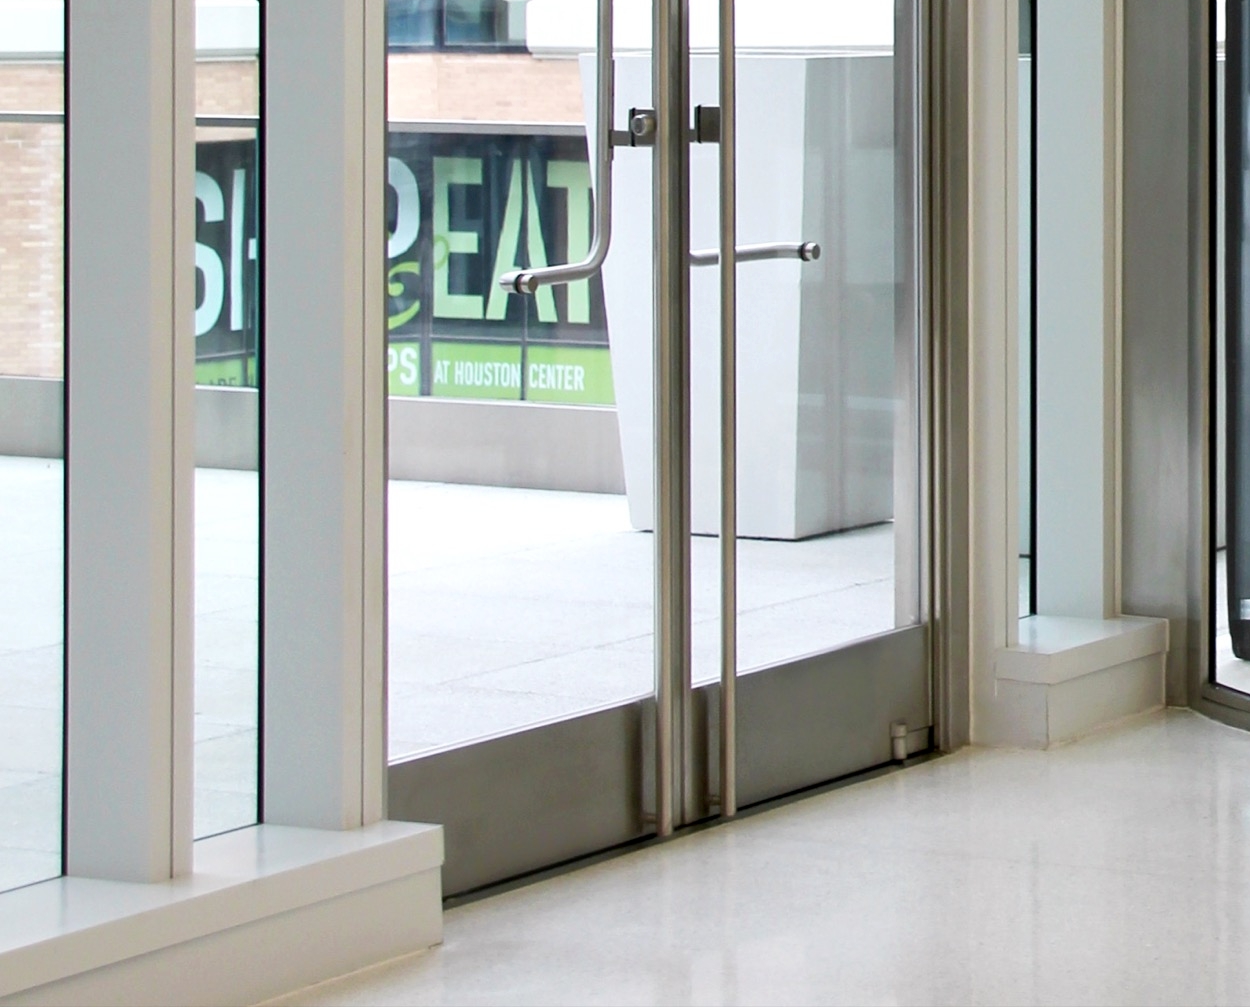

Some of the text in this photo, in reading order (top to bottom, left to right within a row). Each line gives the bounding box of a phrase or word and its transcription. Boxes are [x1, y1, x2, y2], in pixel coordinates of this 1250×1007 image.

[433, 156, 593, 324] EAT
[434, 359, 451, 385] AT
[454, 361, 522, 388] HOUSTON
[528, 363, 585, 391] CENTER
